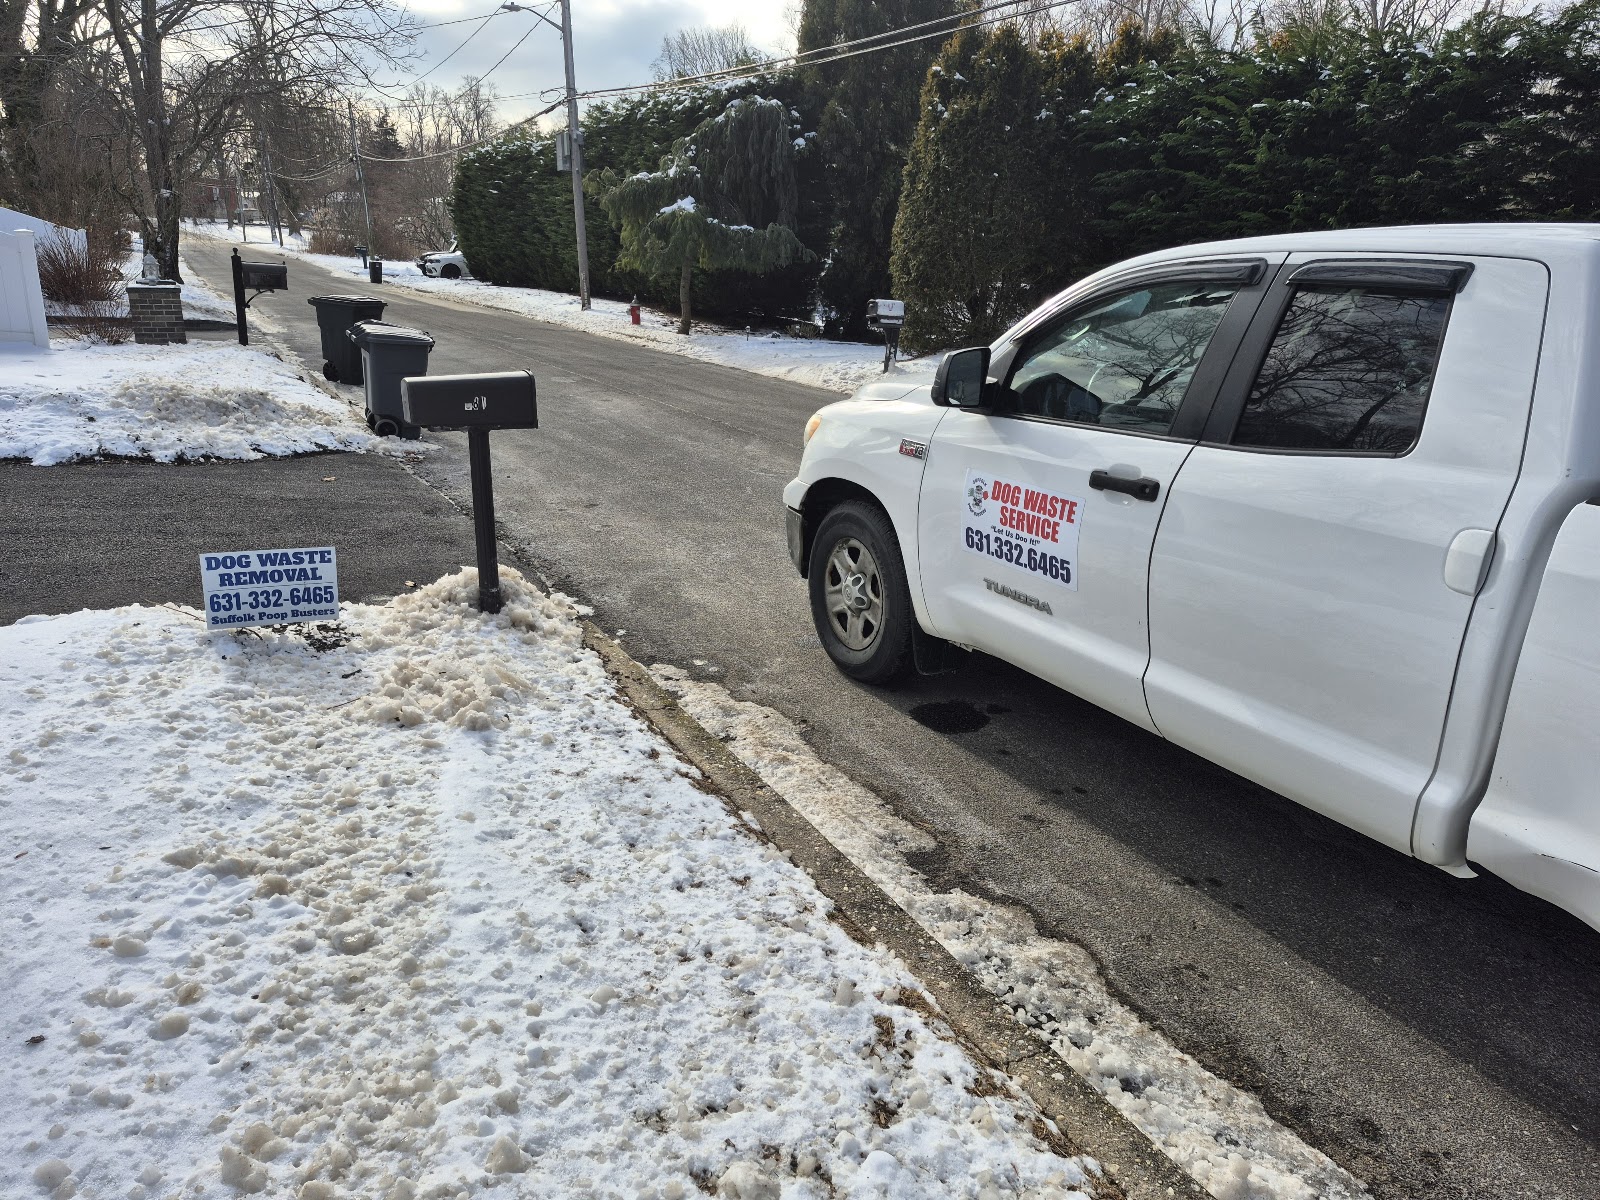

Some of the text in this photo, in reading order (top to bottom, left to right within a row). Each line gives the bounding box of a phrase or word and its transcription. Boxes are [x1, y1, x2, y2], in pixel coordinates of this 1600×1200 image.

[991, 480, 1078, 524] DOG WASTE
[999, 505, 1061, 543] SERVICE
[1005, 530, 1014, 539] Us
[1015, 533, 1028, 543] Doo
[205, 550, 332, 571] DOG WASTE
[965, 526, 1072, 584] 631.332.6465
[218, 567, 323, 587] REMOVAL
[209, 586, 335, 613] 631-332-6465
[983, 577, 1053, 616] TUNDRA
[211, 608, 336, 625] Suffolk Poop Busters
